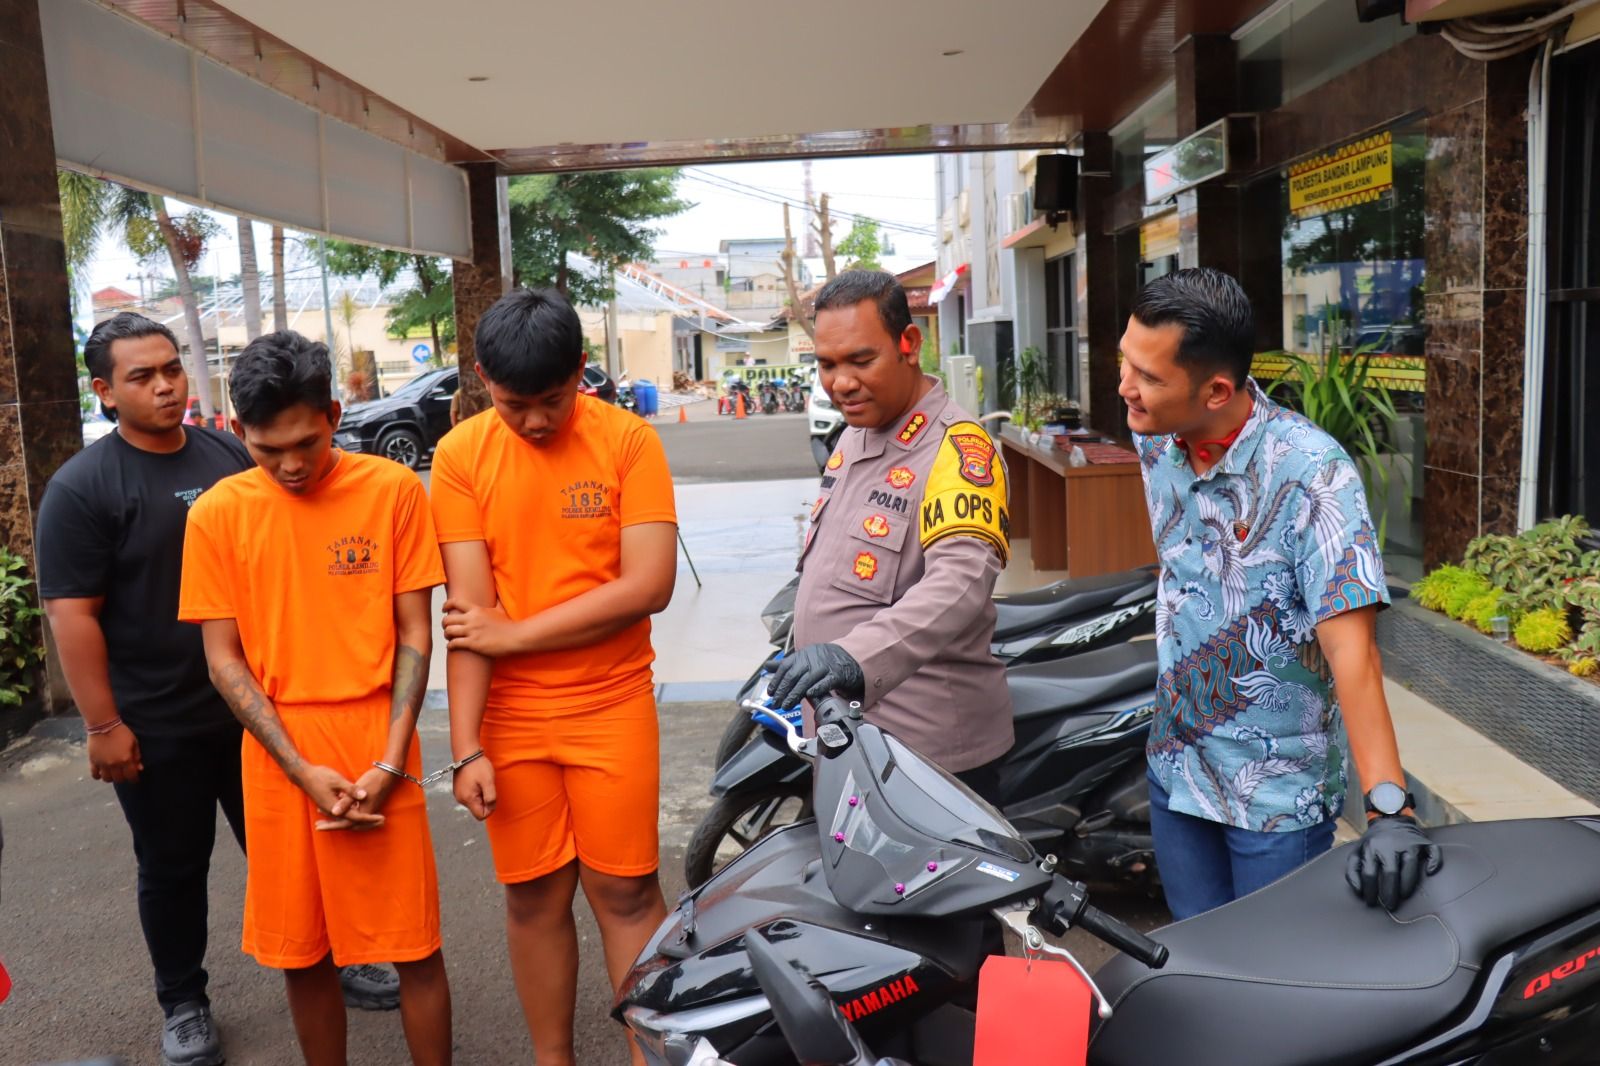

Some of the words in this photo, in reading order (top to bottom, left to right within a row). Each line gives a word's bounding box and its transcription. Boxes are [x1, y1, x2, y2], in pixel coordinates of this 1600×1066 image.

[1292, 172, 1322, 192] POLRESTA
[1323, 162, 1350, 182] BANDAR
[1351, 150, 1388, 174] LAMPUNG
[560, 480, 609, 496] TAHANAN
[570, 492, 603, 508] 185
[868, 489, 908, 513] POLRI
[923, 498, 945, 533] KA
[954, 493, 992, 524] OPS
[326, 536, 379, 552] TAHANAN
[838, 975, 919, 1022] YAMAHA
